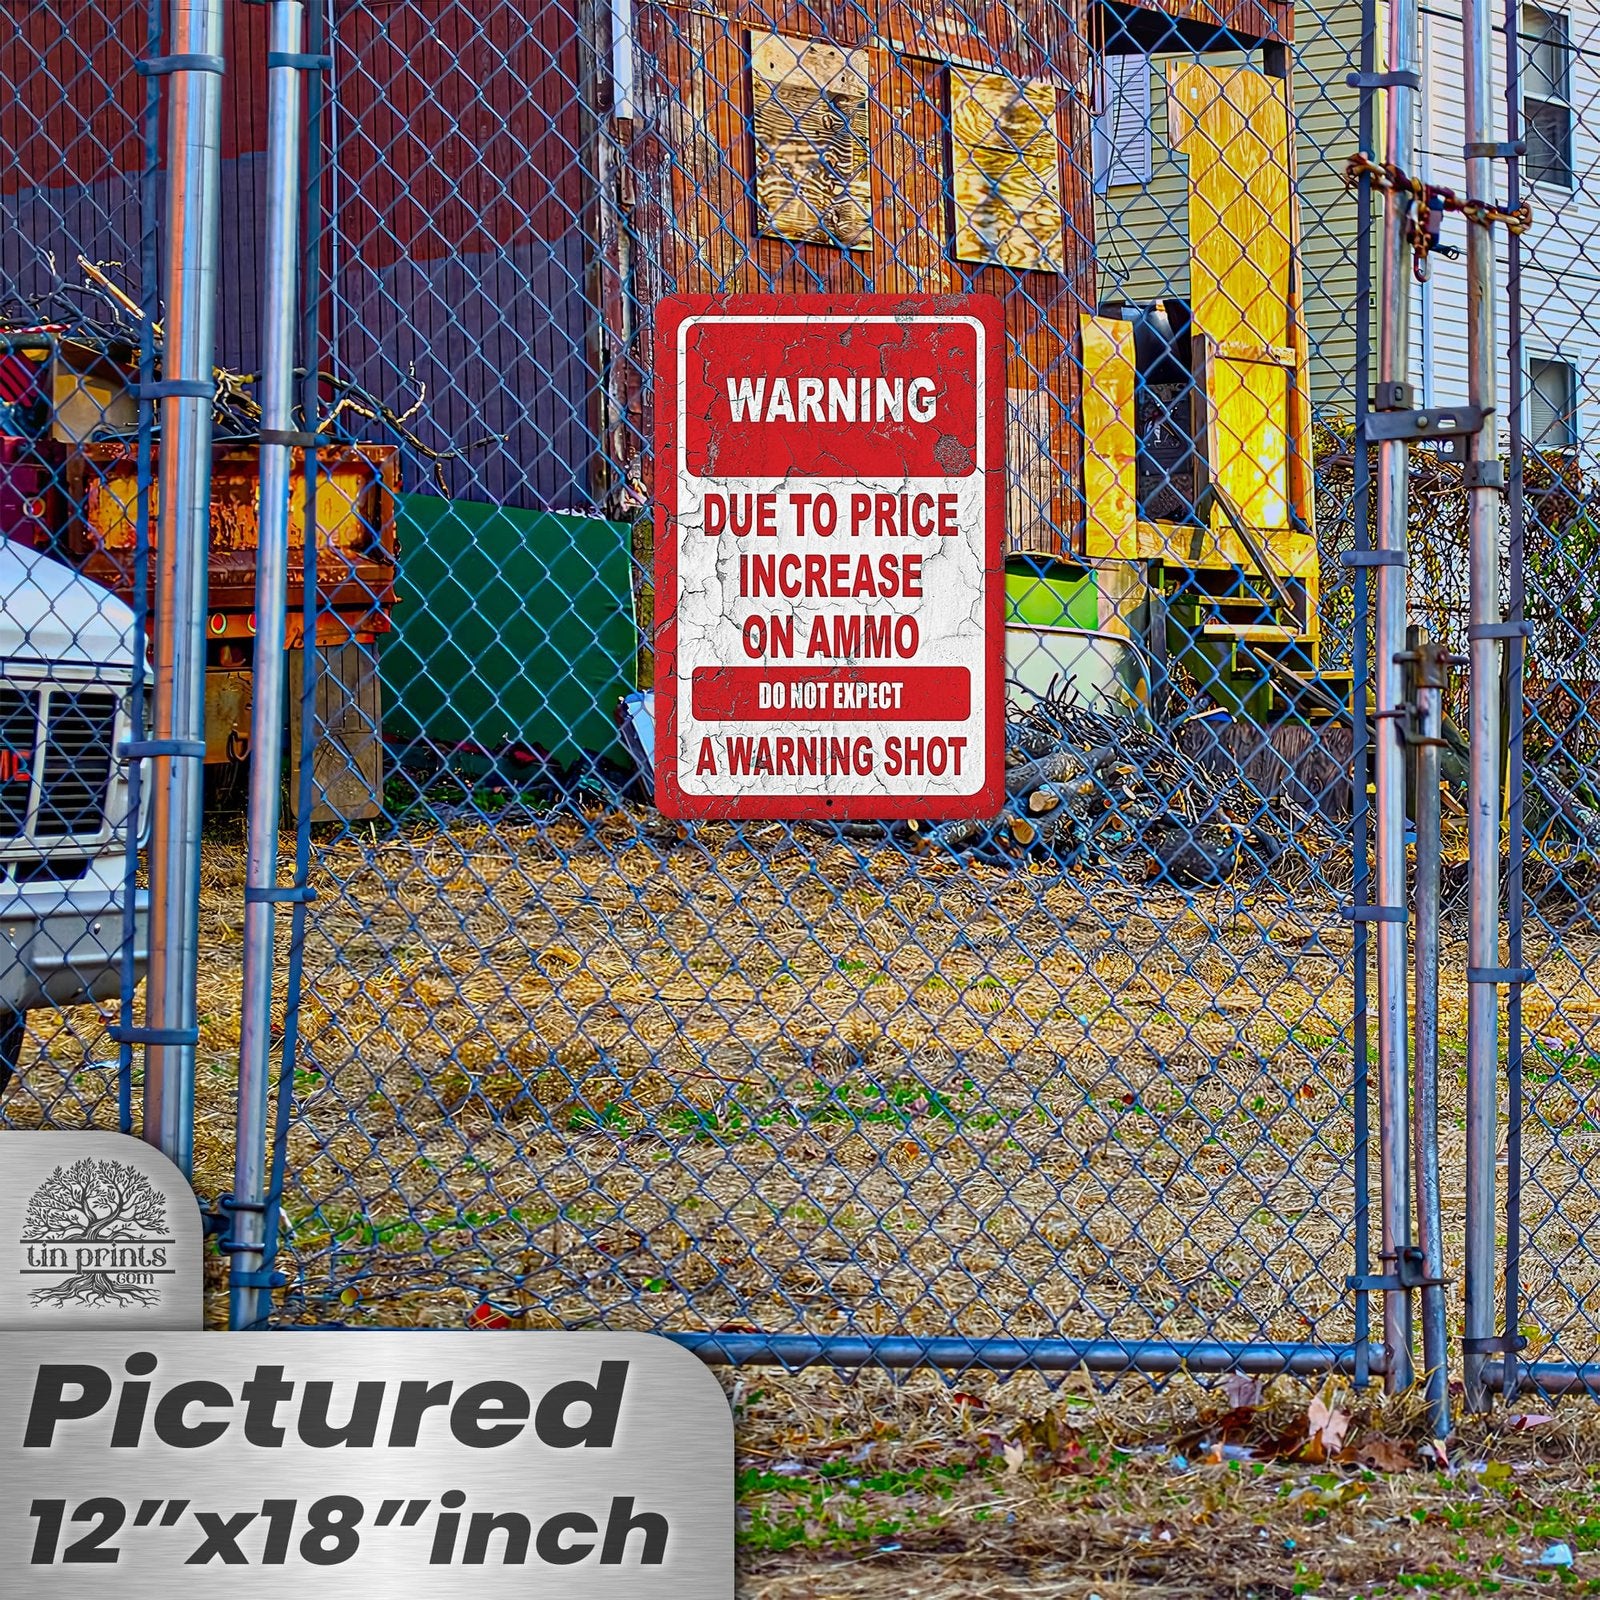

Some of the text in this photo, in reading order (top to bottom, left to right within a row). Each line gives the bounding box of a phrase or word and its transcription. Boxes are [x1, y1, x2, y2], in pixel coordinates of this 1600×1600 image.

[726, 377, 937, 423] WARNING
[704, 493, 959, 537] DUE TO PRICE
[740, 554, 923, 598] INCREASE
[742, 615, 920, 659] ON AMMO
[758, 682, 904, 709] DO NOT EXPECT
[695, 737, 967, 776] A WARNING SHOT
